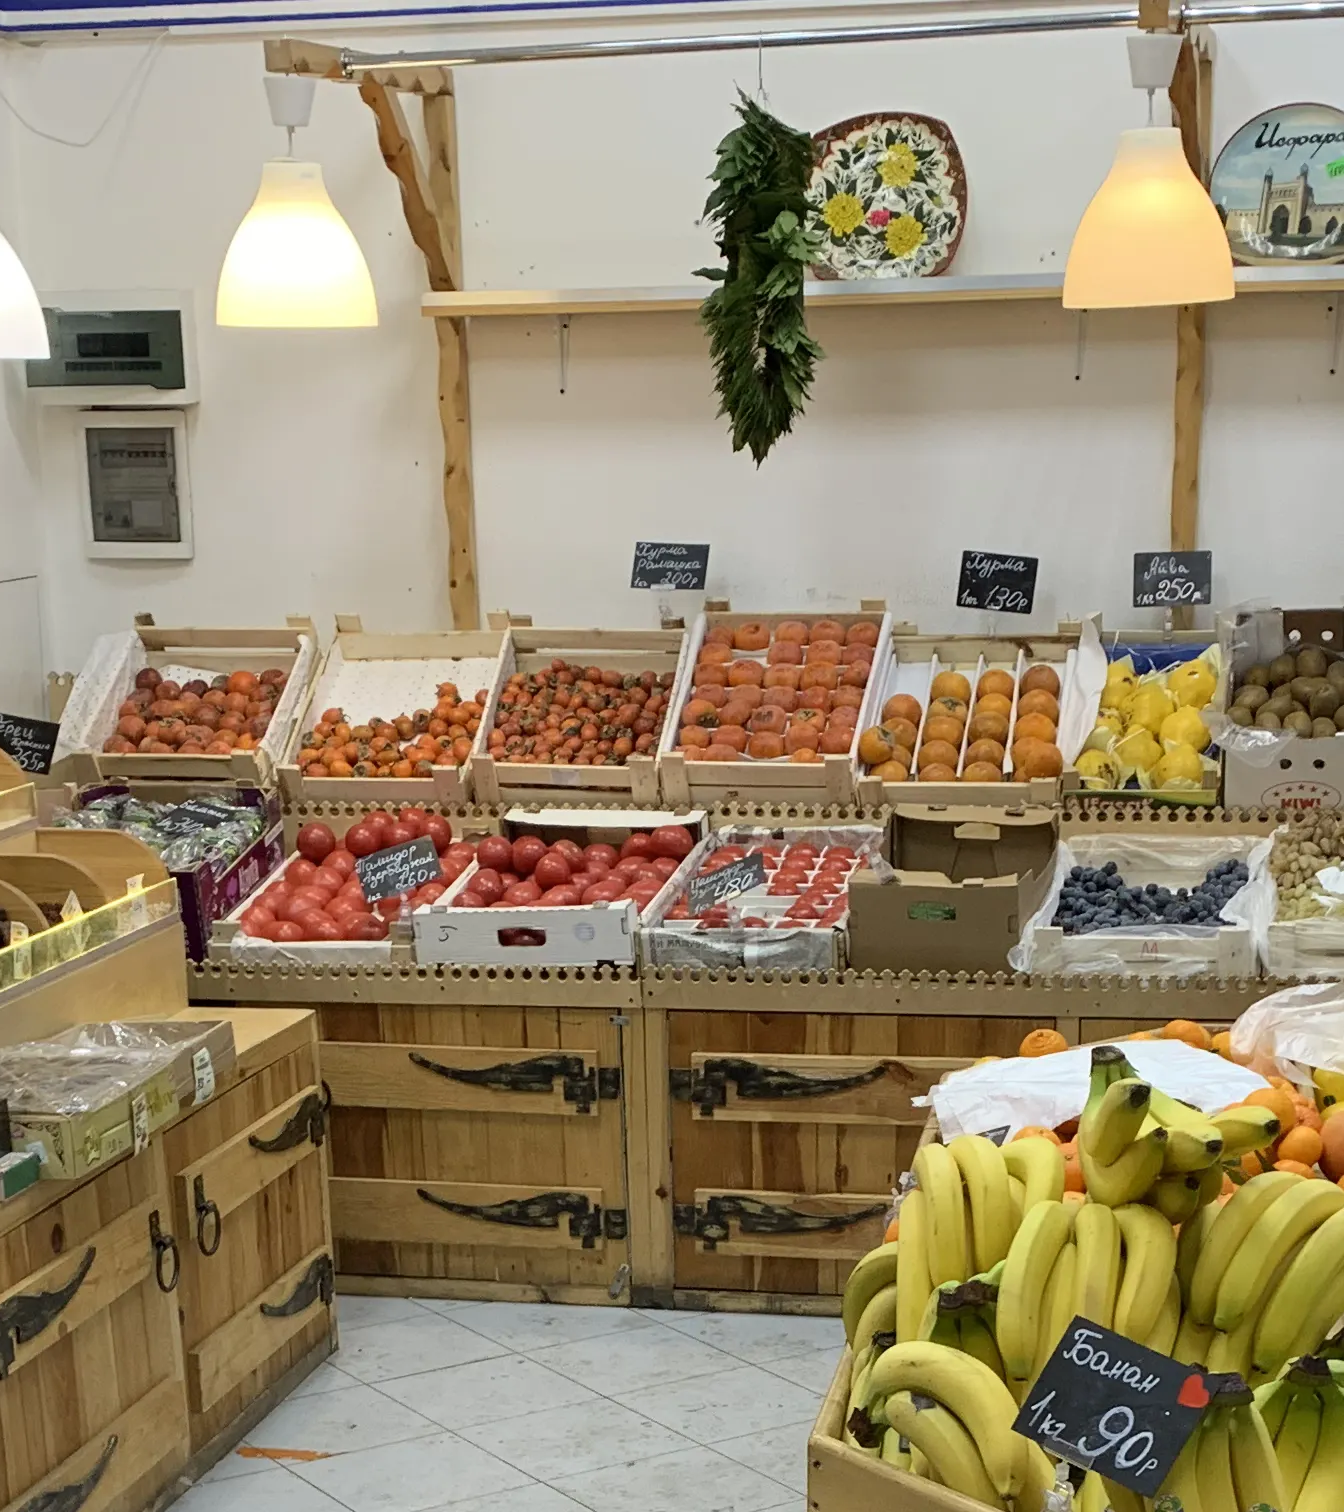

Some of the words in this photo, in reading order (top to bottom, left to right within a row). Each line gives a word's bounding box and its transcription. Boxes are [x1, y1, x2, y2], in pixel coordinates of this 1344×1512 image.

[966, 552, 1028, 577] Хурма
[1144, 557, 1190, 581] Айва
[1063, 1328, 1161, 1393] Банан
[1077, 1405, 1159, 1477] 90р
